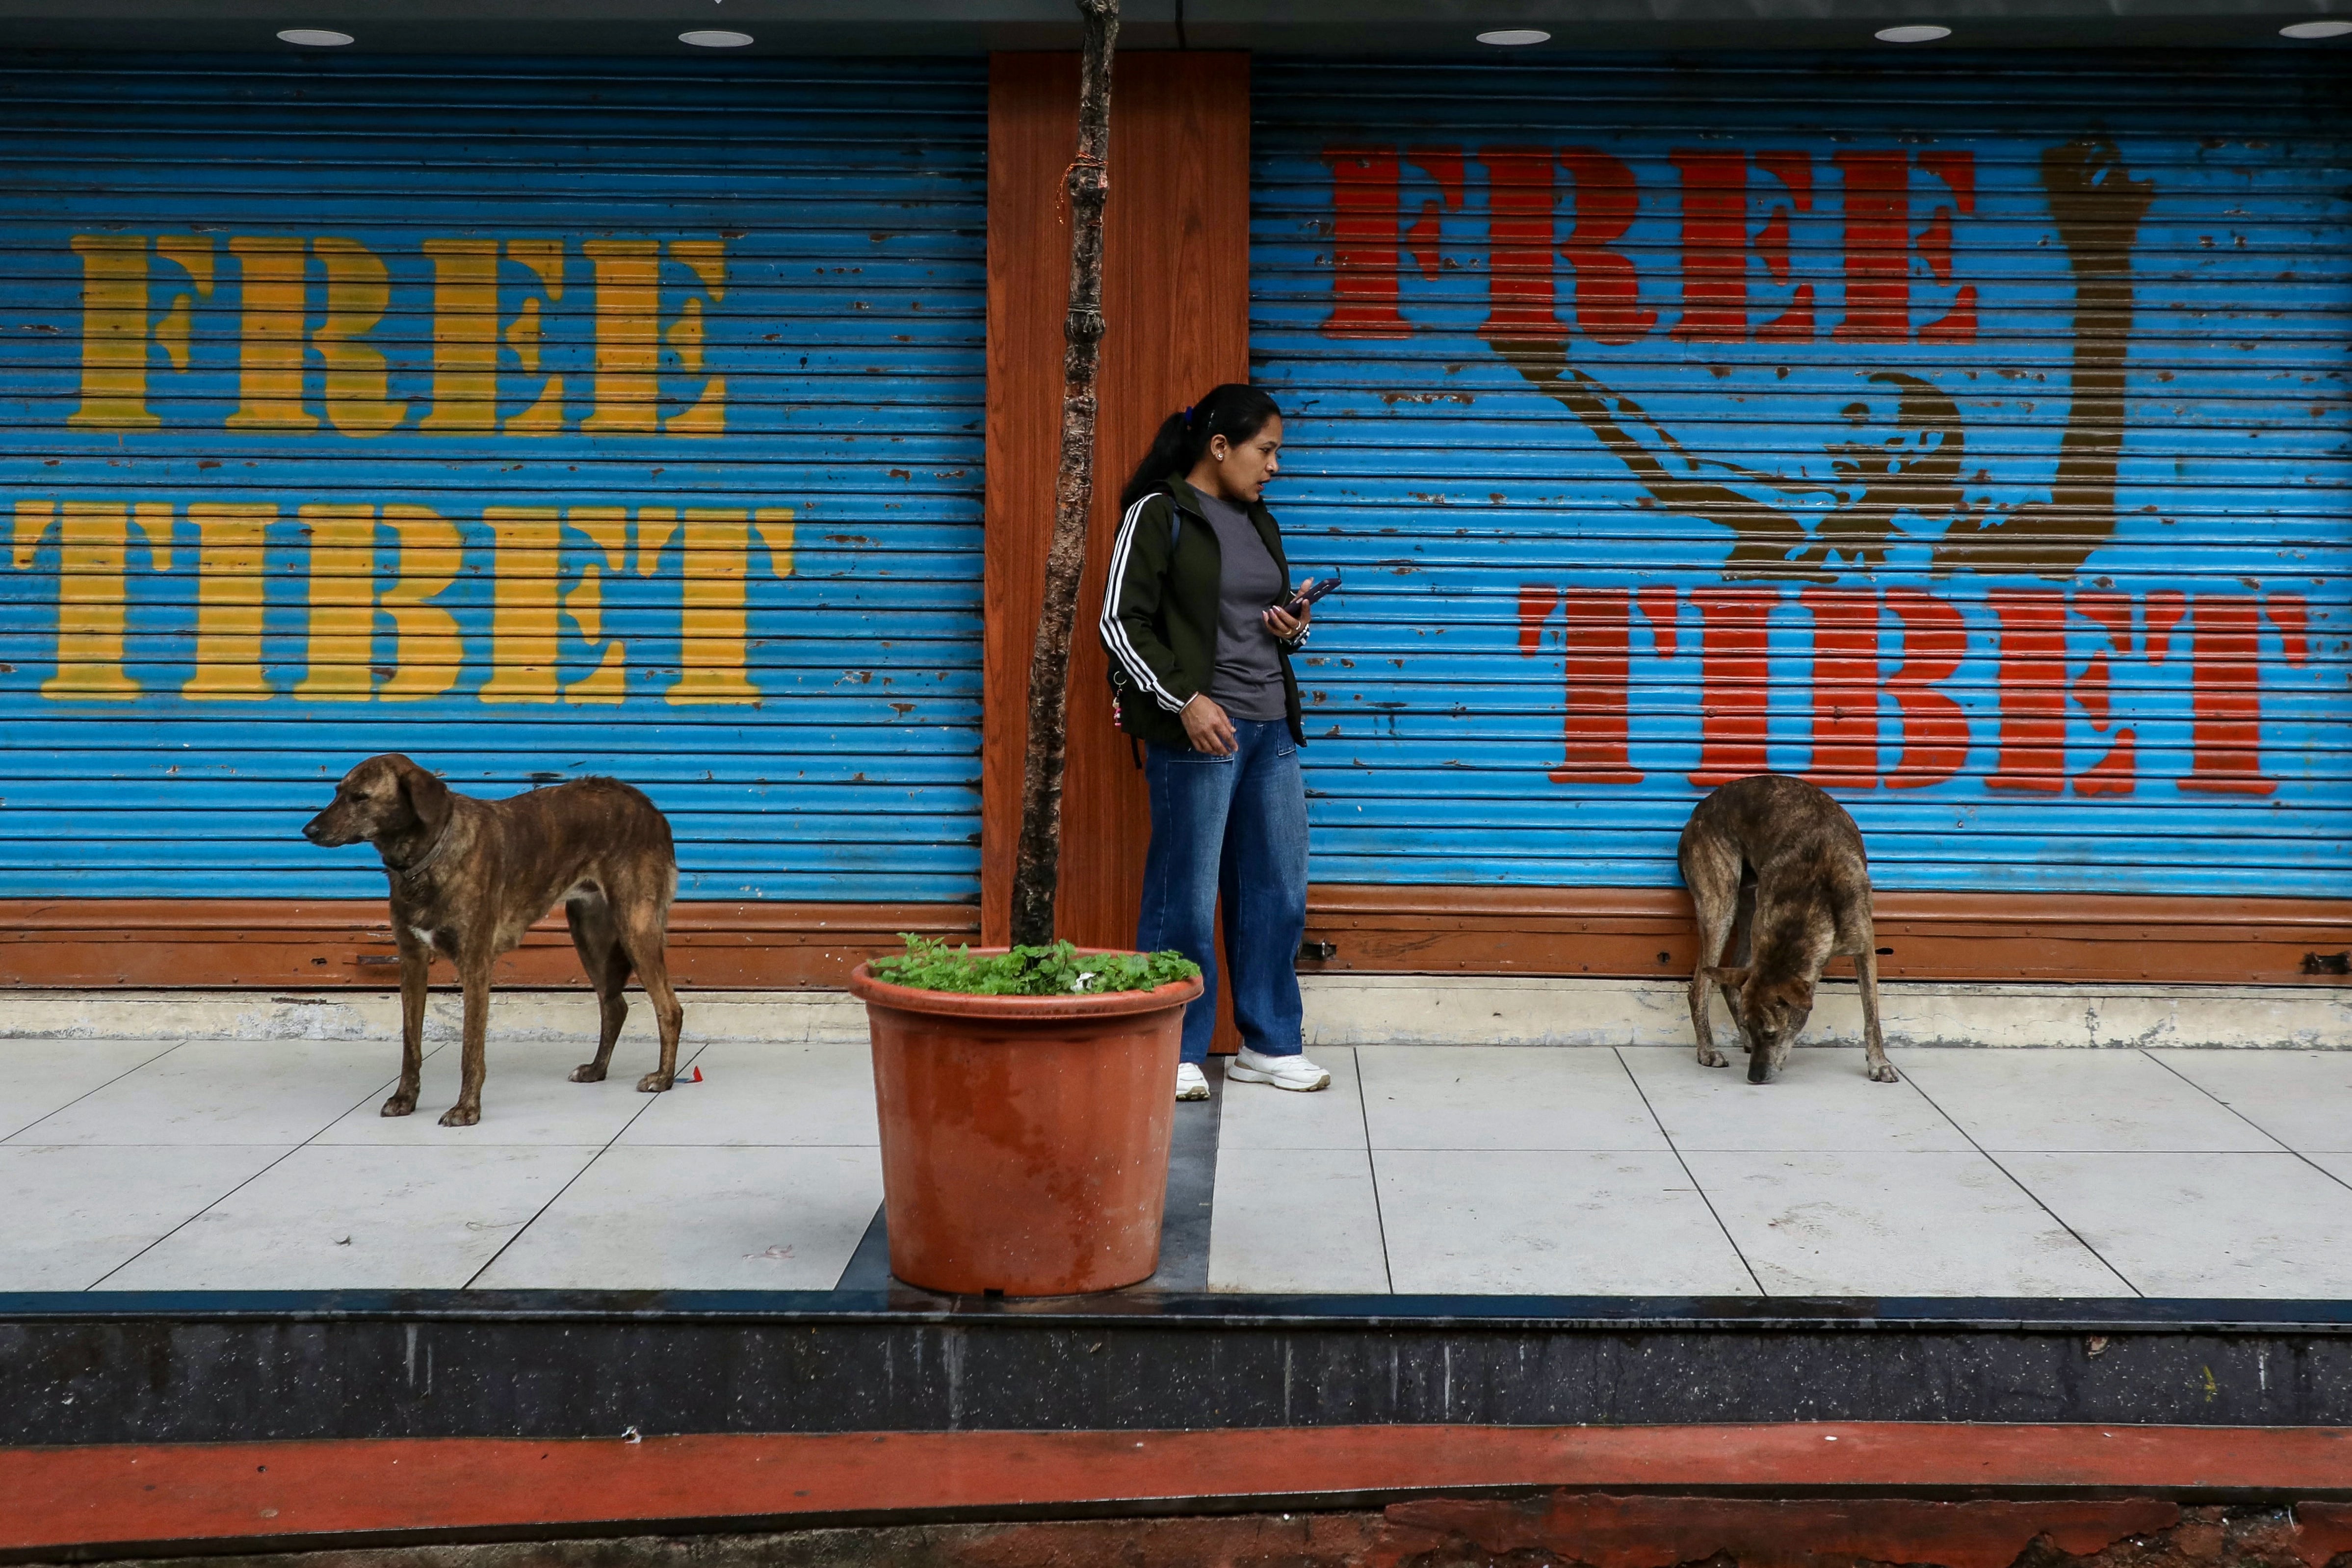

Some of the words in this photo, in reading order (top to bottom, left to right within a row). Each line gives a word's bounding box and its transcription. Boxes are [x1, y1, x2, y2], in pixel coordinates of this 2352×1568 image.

[67, 235, 727, 437] FREE
[1321, 145, 1978, 344] FREE
[11, 501, 796, 706] TIBET
[1517, 584, 2308, 796] TIBET
